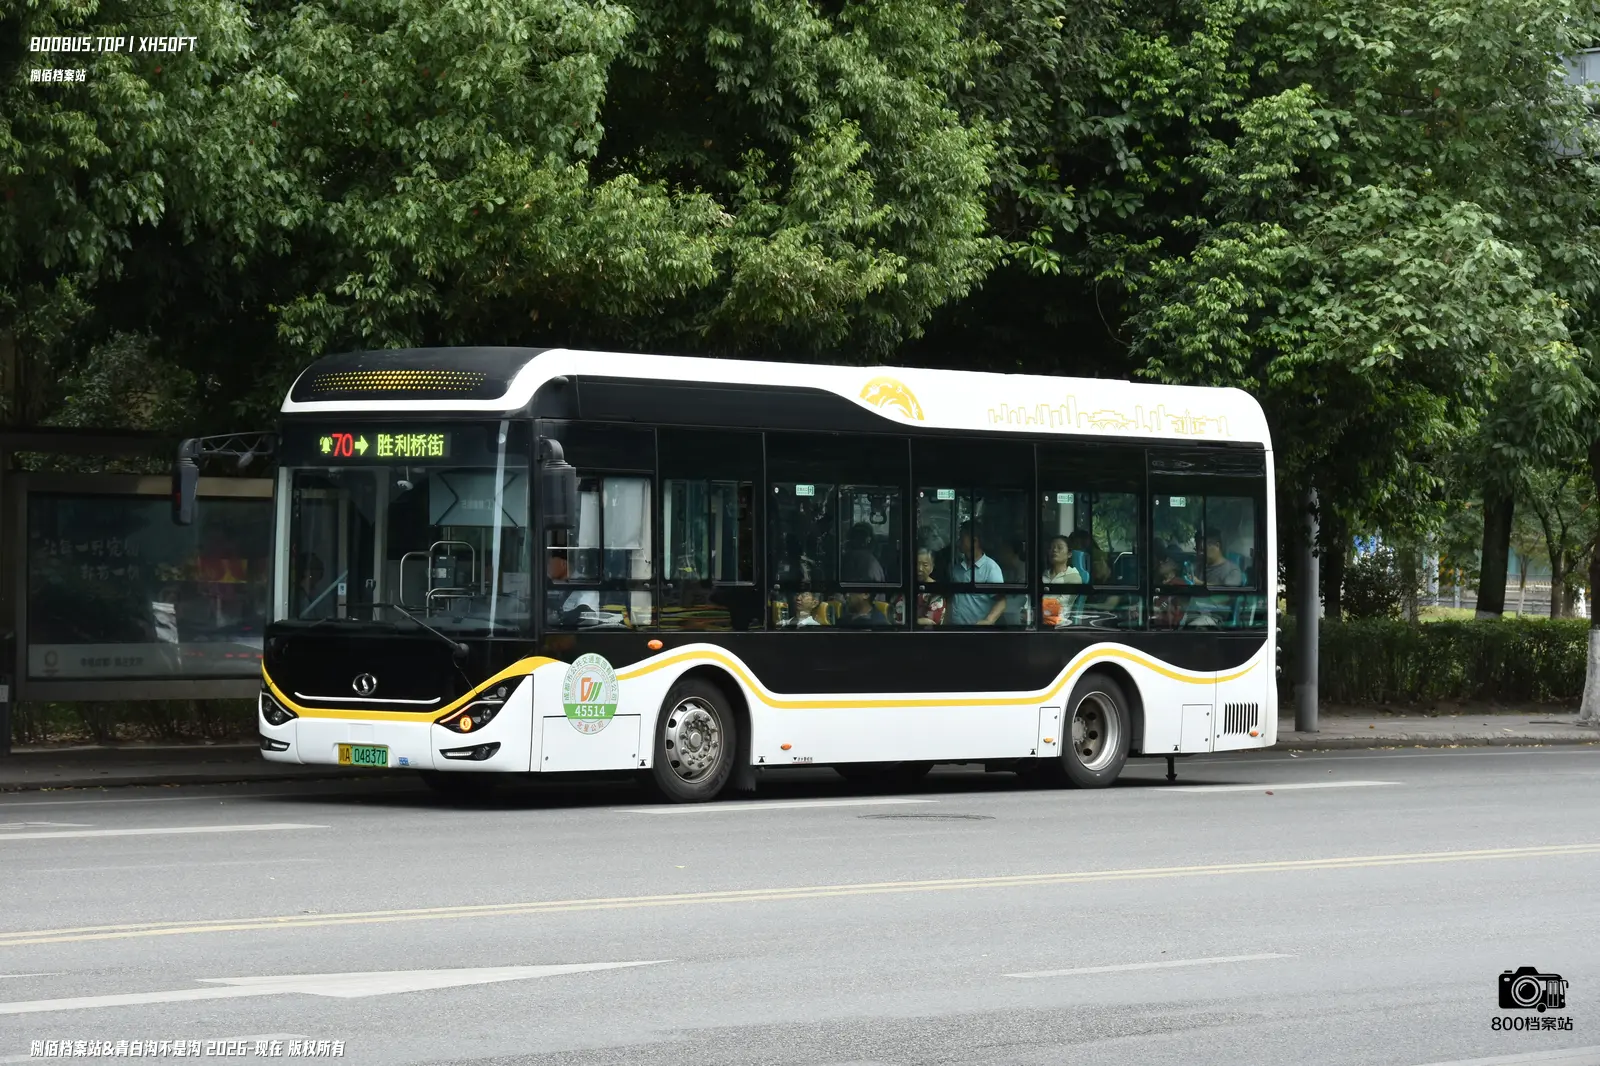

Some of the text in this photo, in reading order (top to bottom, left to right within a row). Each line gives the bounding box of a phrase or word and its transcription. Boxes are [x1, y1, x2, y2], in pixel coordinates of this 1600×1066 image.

[332, 433, 444, 457] 70 胜利桥街
[575, 705, 605, 717] 45514
